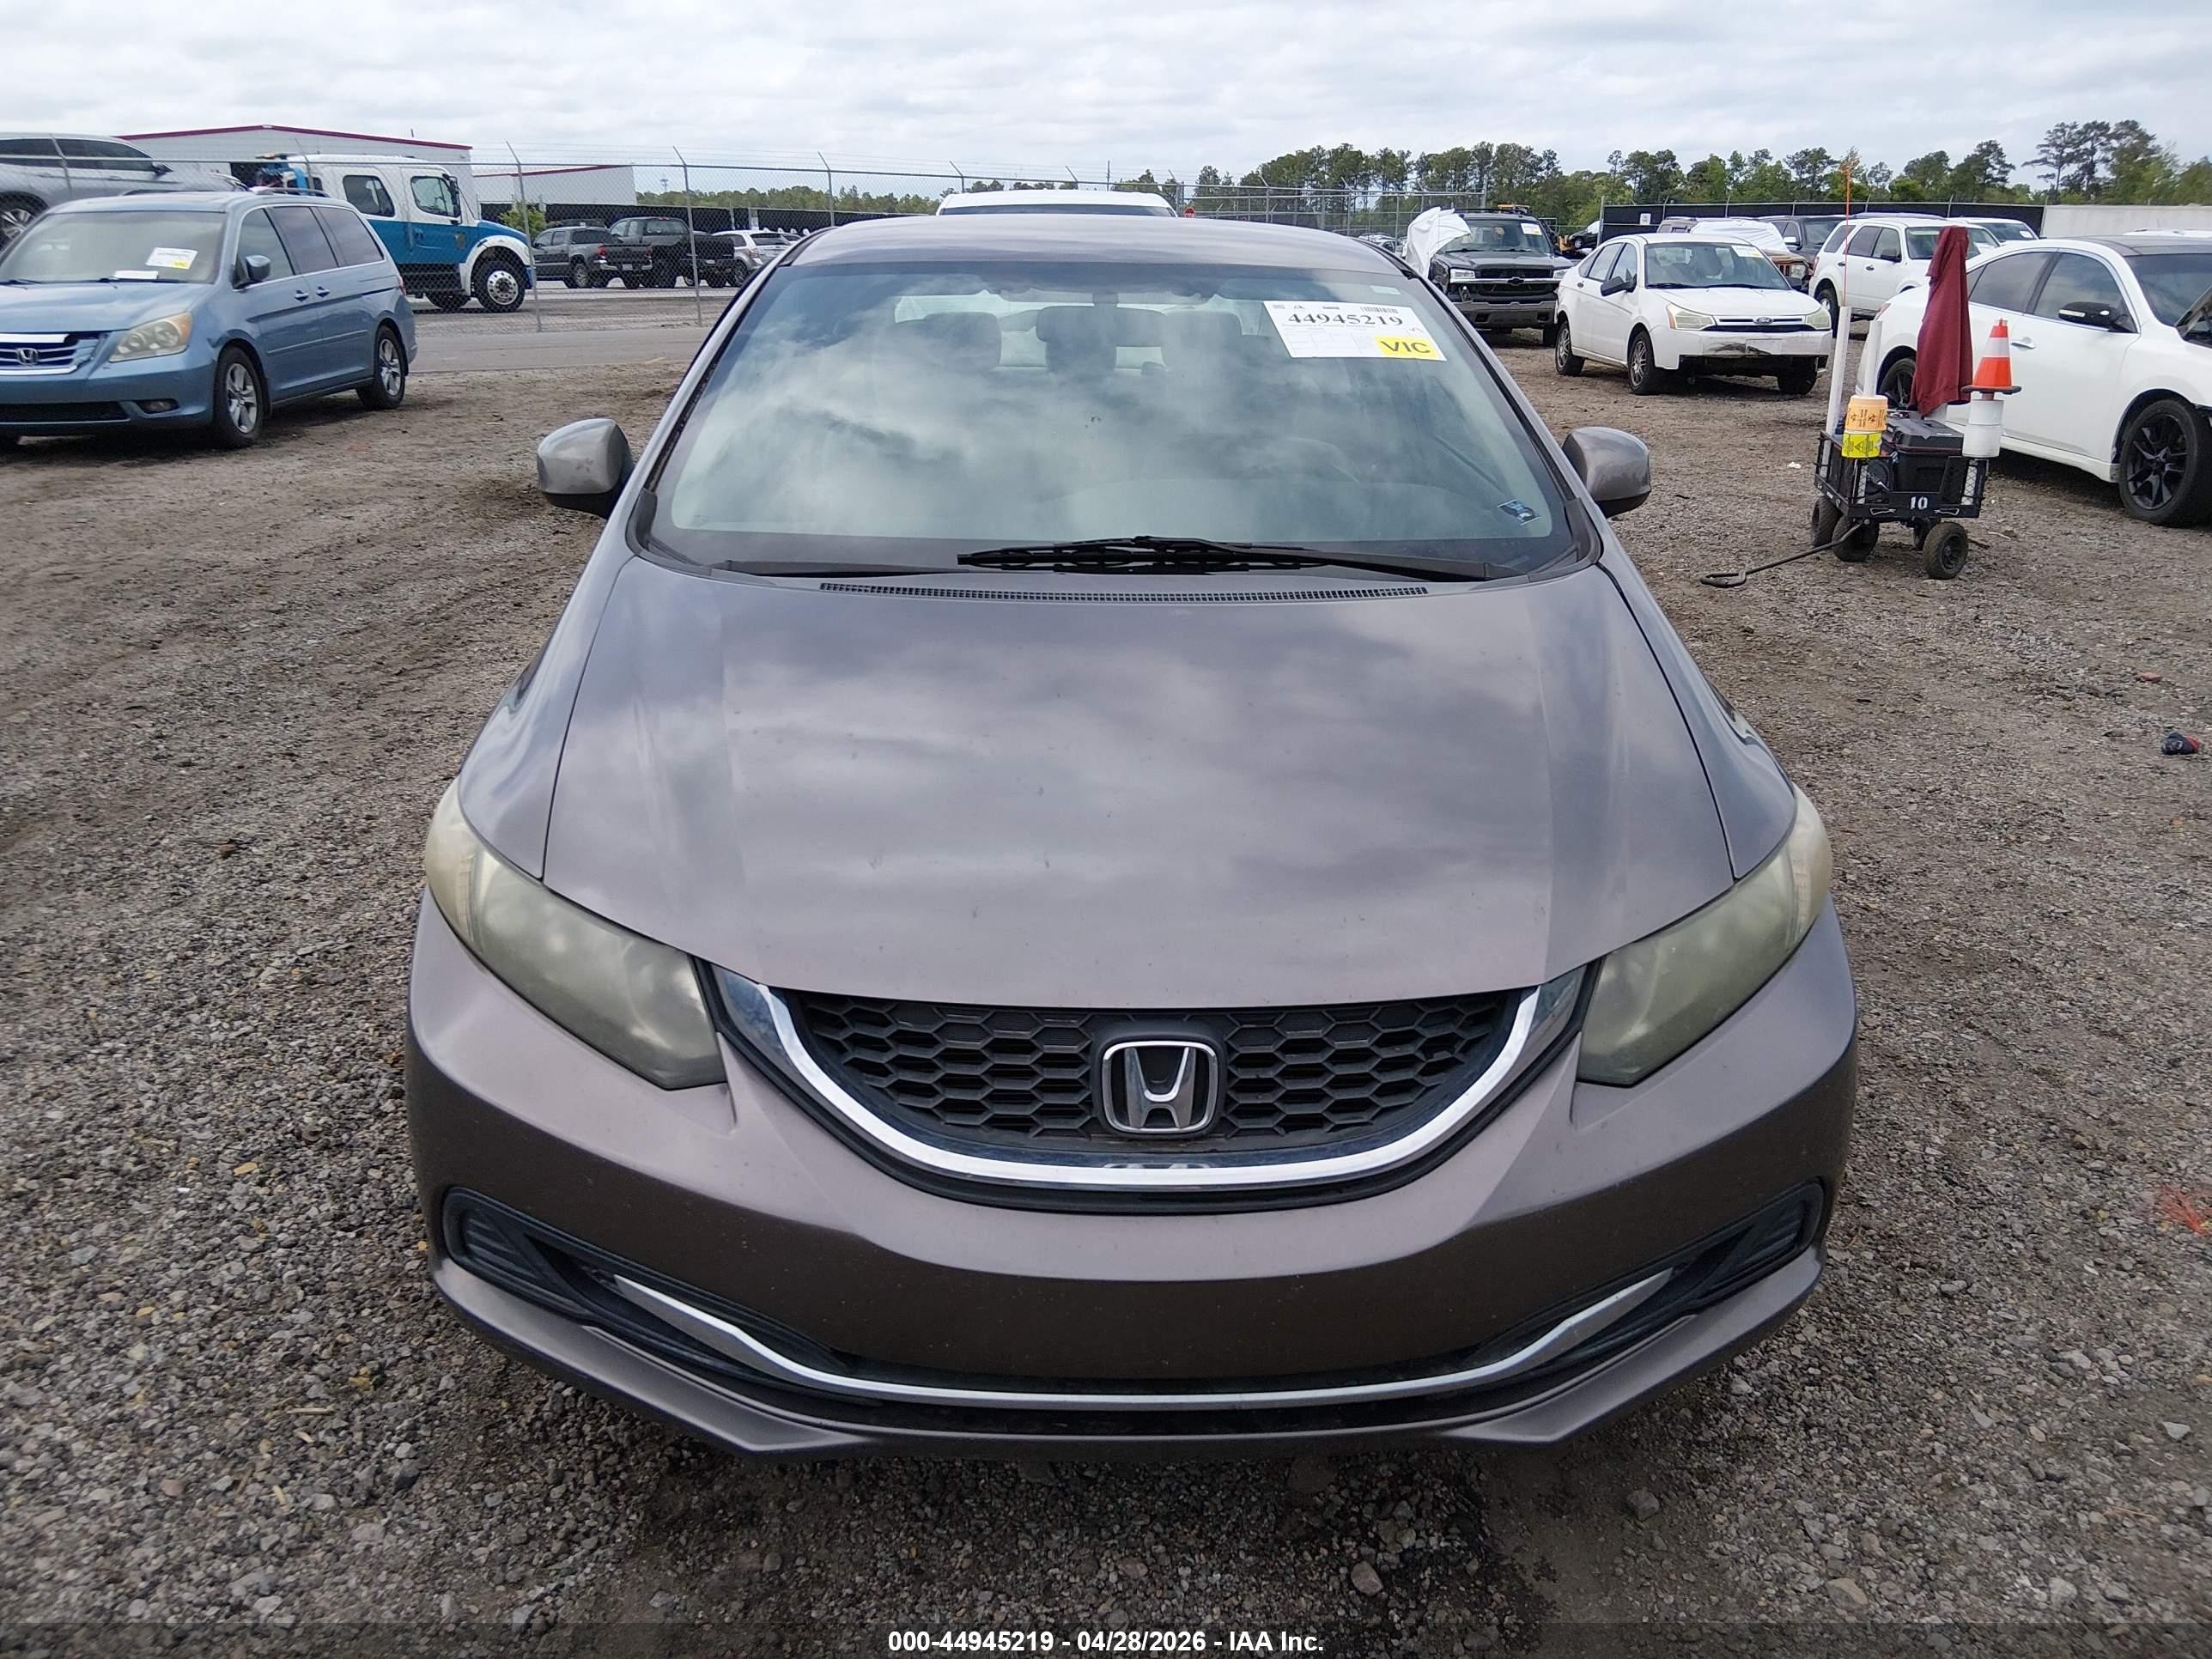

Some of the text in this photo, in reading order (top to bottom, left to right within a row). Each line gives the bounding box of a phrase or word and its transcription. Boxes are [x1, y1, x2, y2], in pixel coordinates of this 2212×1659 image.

[1288, 313, 1403, 325] 44945219
[1380, 340, 1431, 354] VIC
[1910, 495, 1929, 510] 10
